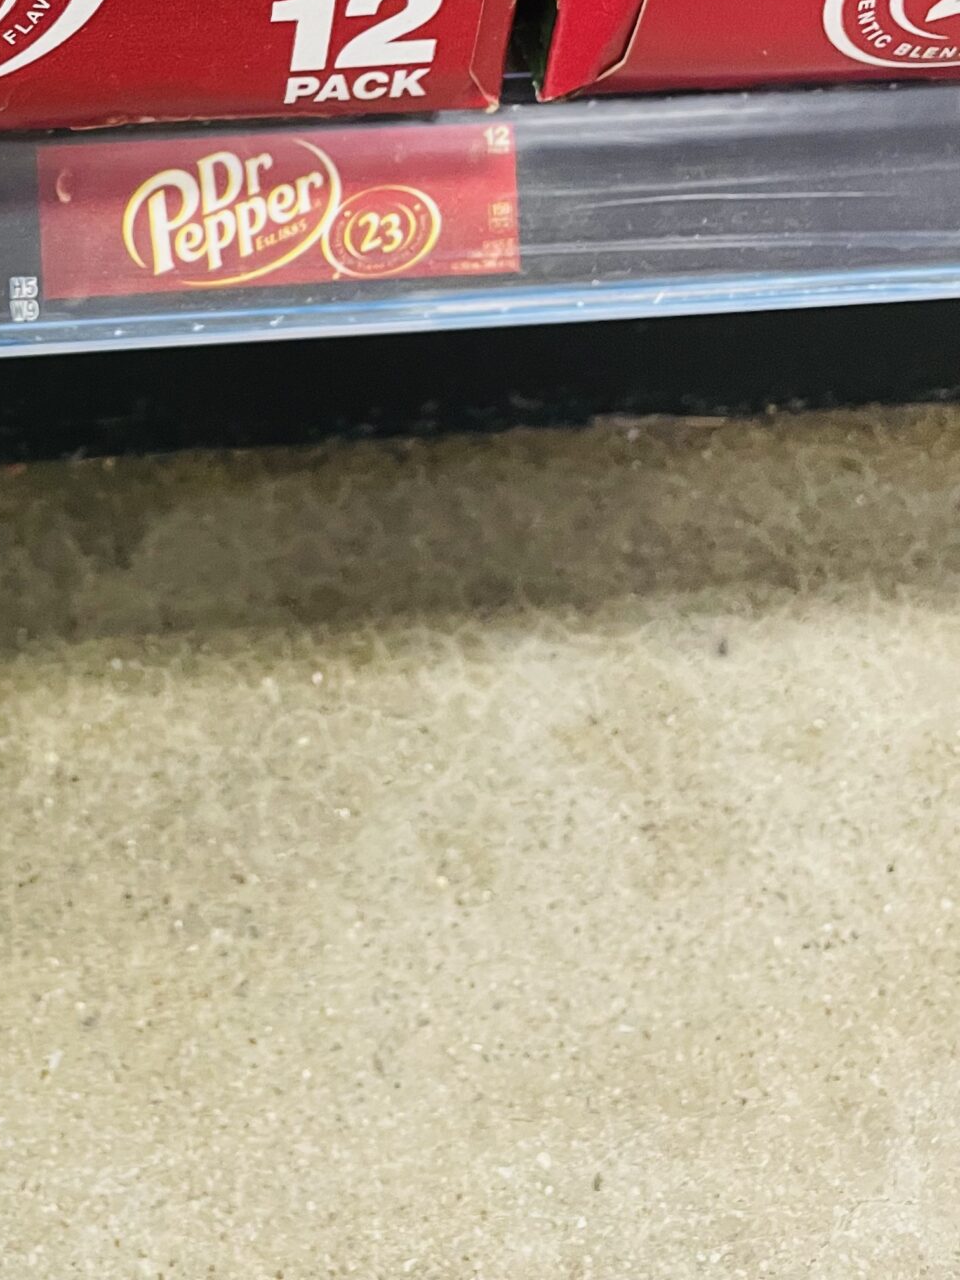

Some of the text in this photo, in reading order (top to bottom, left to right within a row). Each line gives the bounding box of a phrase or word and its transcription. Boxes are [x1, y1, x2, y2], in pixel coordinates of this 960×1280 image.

[893, 42, 960, 60] BLEN
[283, 67, 431, 104] PACK
[197, 151, 273, 215] Dr
[122, 168, 324, 276] Pepper
[358, 211, 404, 254] 23
